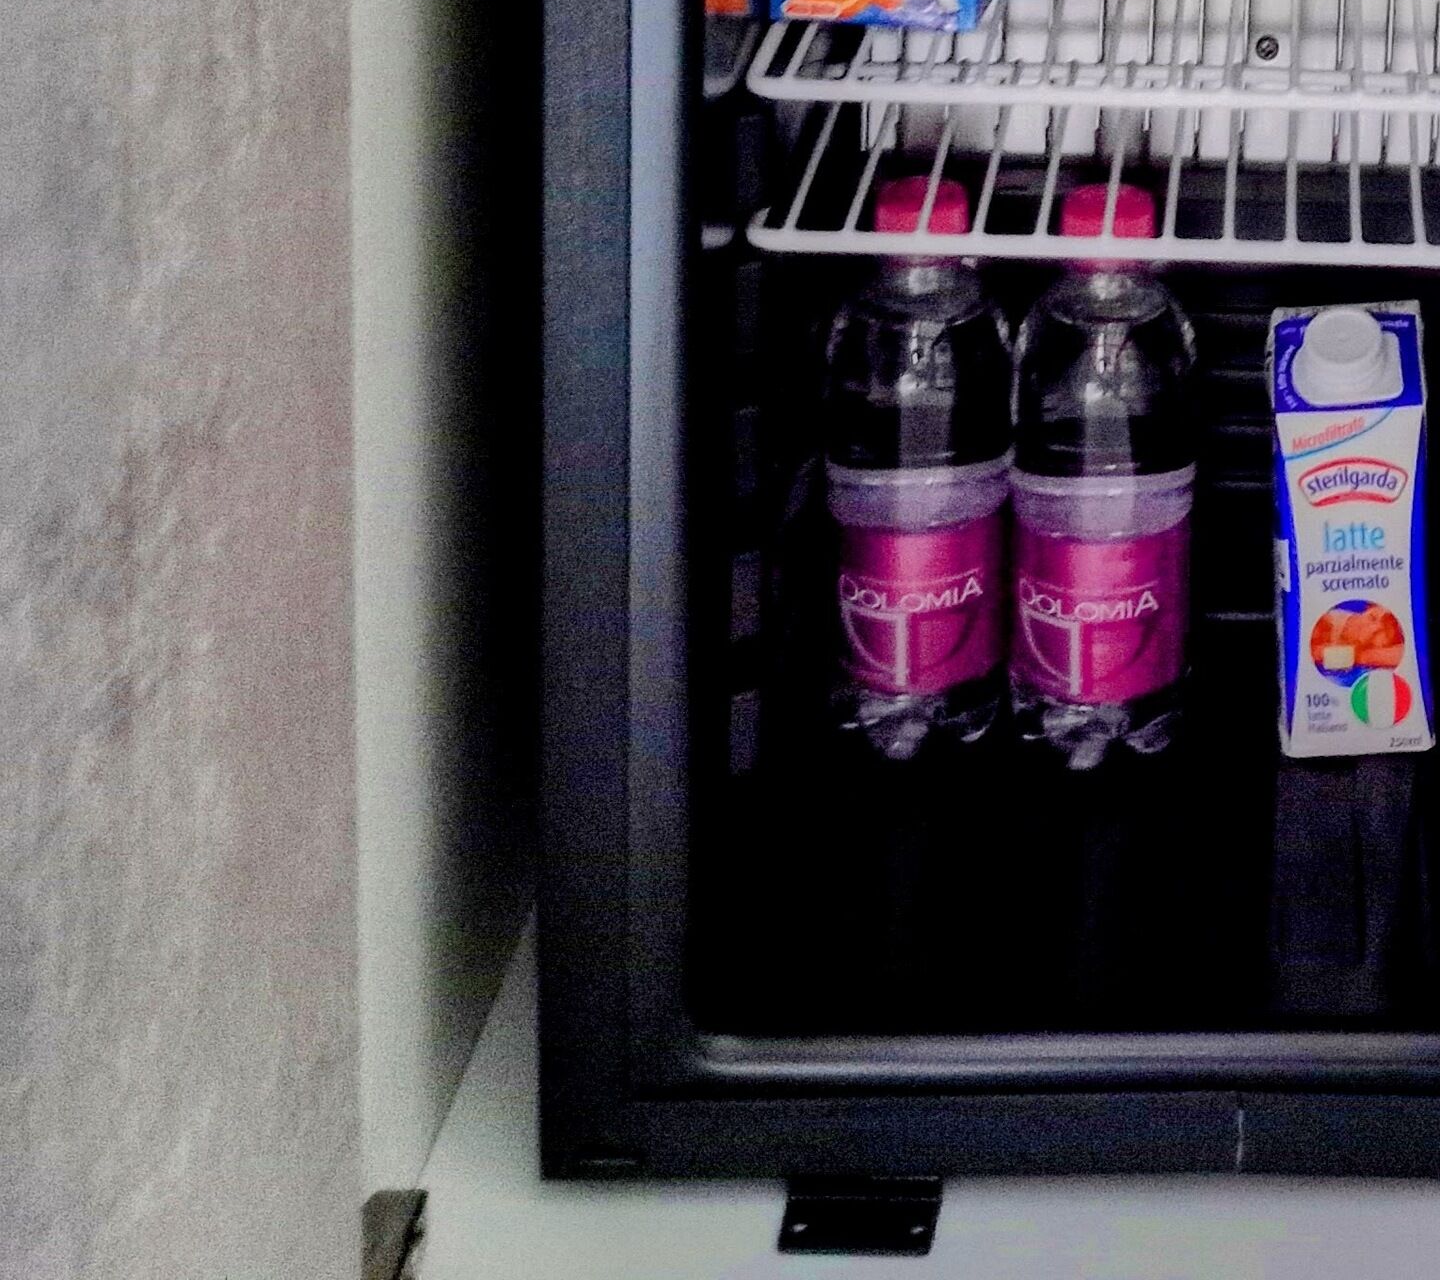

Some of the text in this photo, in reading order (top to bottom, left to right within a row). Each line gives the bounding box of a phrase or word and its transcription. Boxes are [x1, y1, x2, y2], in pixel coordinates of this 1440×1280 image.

[1306, 465, 1398, 495] sterilgarda
[1323, 521, 1385, 552] latte
[1306, 554, 1404, 578] parzialmente
[1322, 574, 1389, 592] scremato
